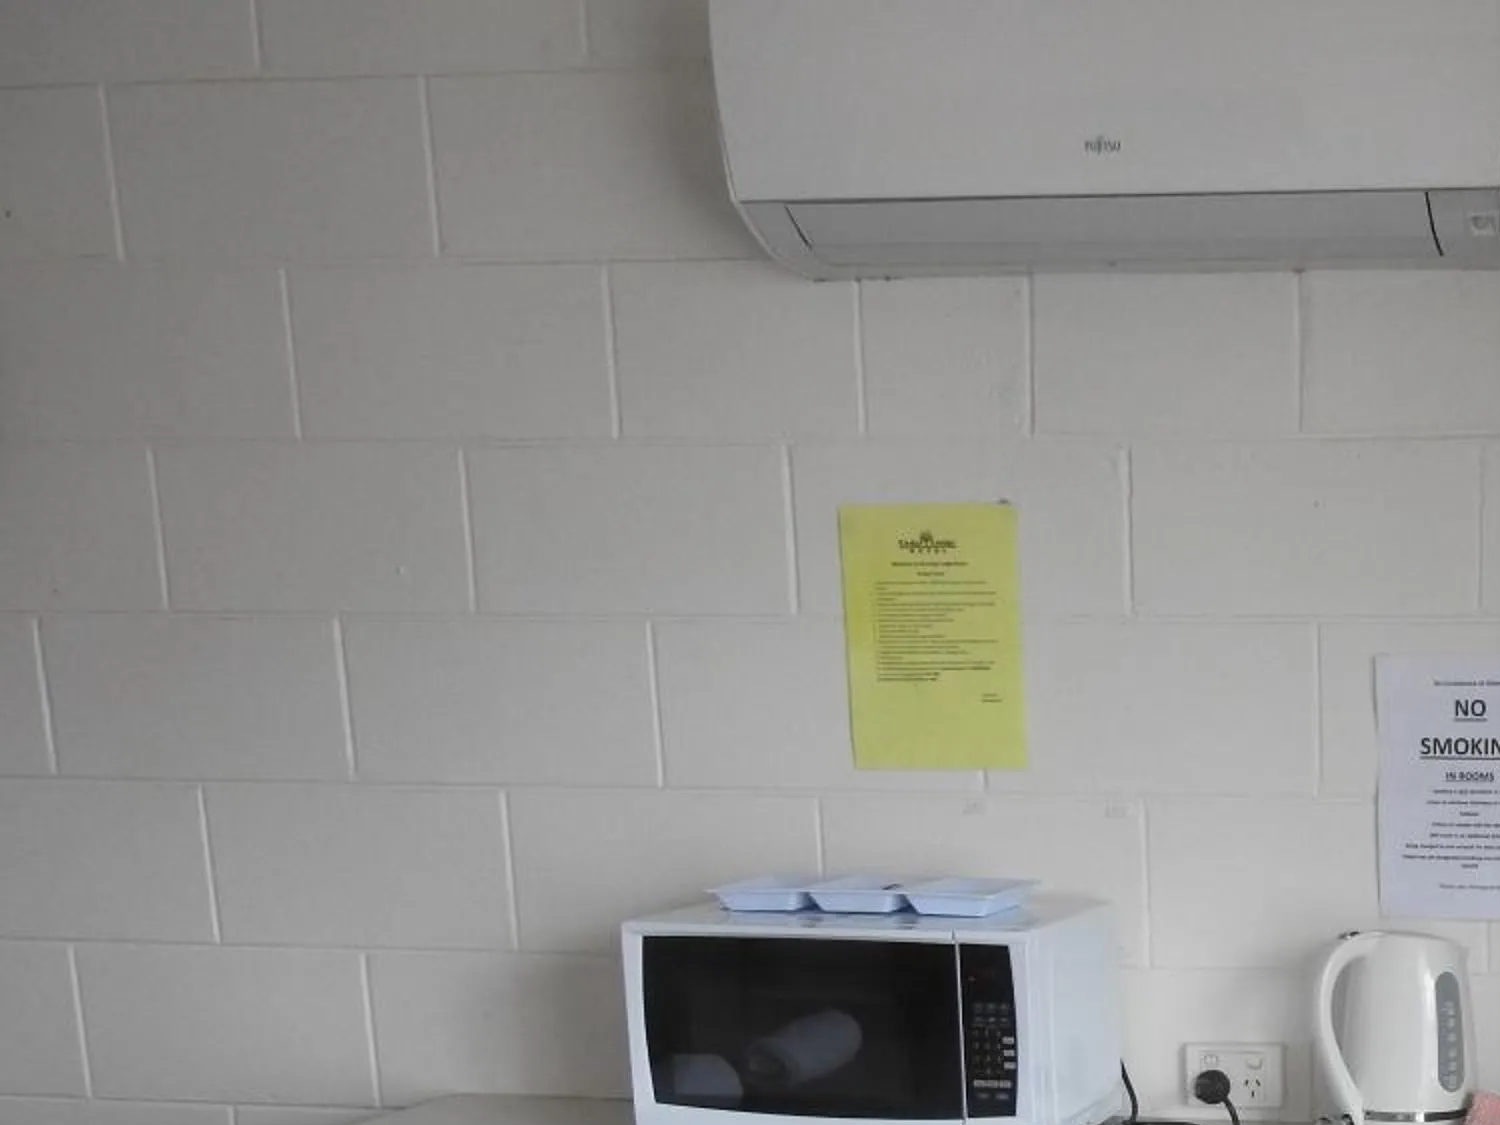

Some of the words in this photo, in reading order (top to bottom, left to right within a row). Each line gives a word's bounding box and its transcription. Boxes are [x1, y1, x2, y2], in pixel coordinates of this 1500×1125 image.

[1455, 699, 1487, 717] NO
[1445, 771, 1457, 781] IN
[1459, 771, 1494, 781] ROOMS
